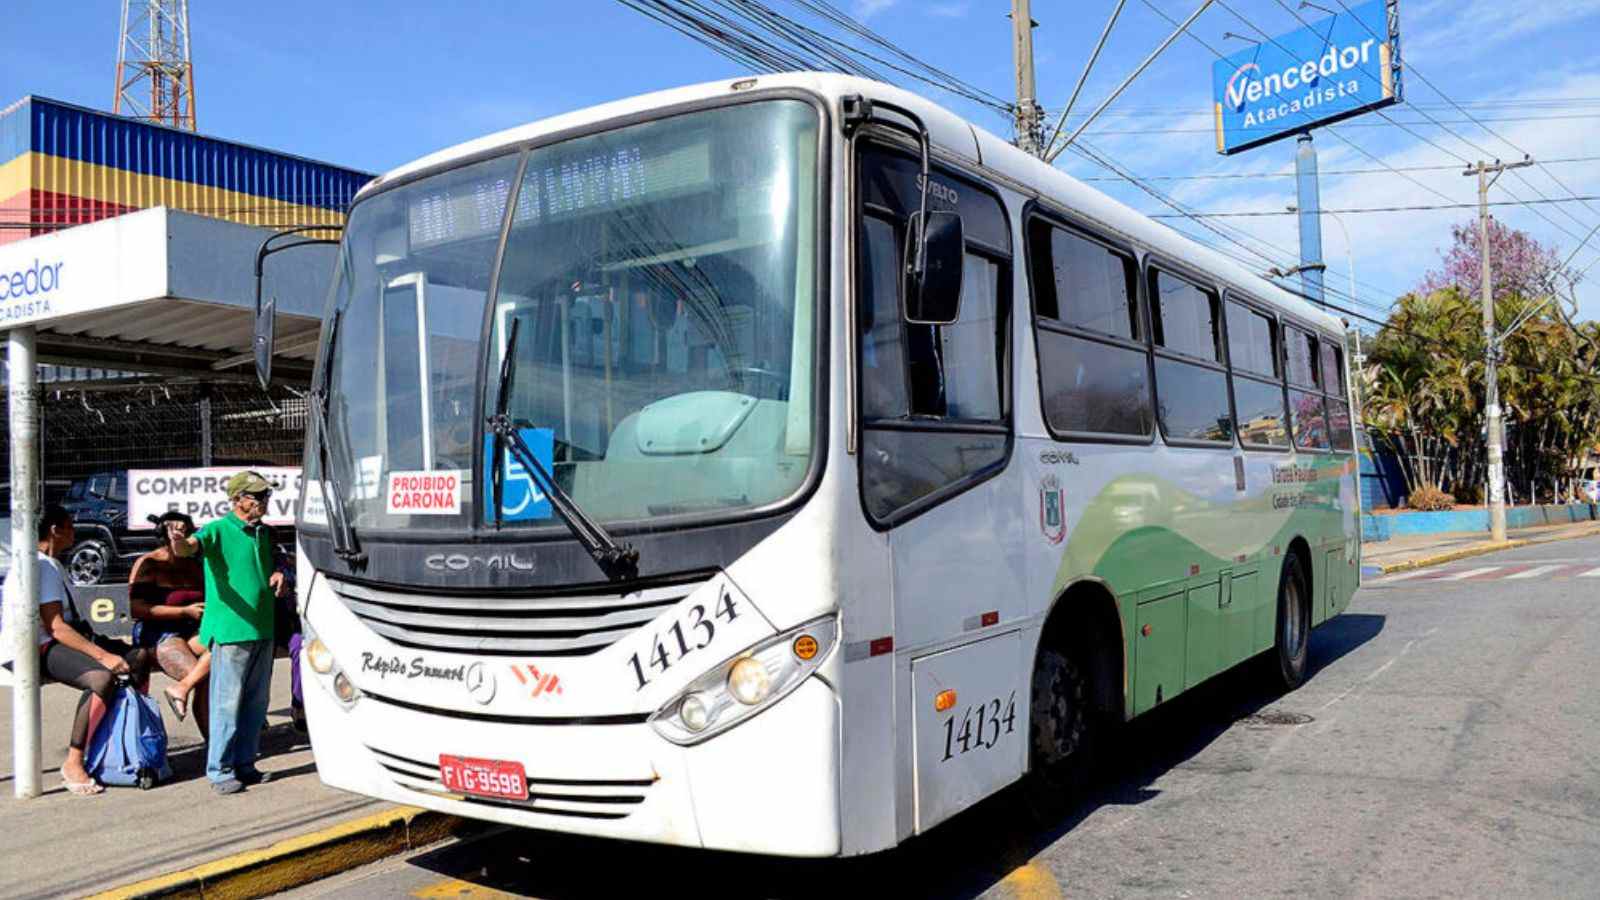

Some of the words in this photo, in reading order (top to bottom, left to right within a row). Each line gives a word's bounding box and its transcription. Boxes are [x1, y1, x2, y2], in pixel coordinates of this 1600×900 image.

[1226, 38, 1375, 109] Vencedor
[1243, 79, 1360, 128] Atacadista
[392, 476, 456, 491] PROIBIDO
[392, 493, 456, 509] CARONA
[187, 501, 231, 518] PAG
[627, 583, 742, 692] 14134
[941, 690, 1016, 762] 14134
